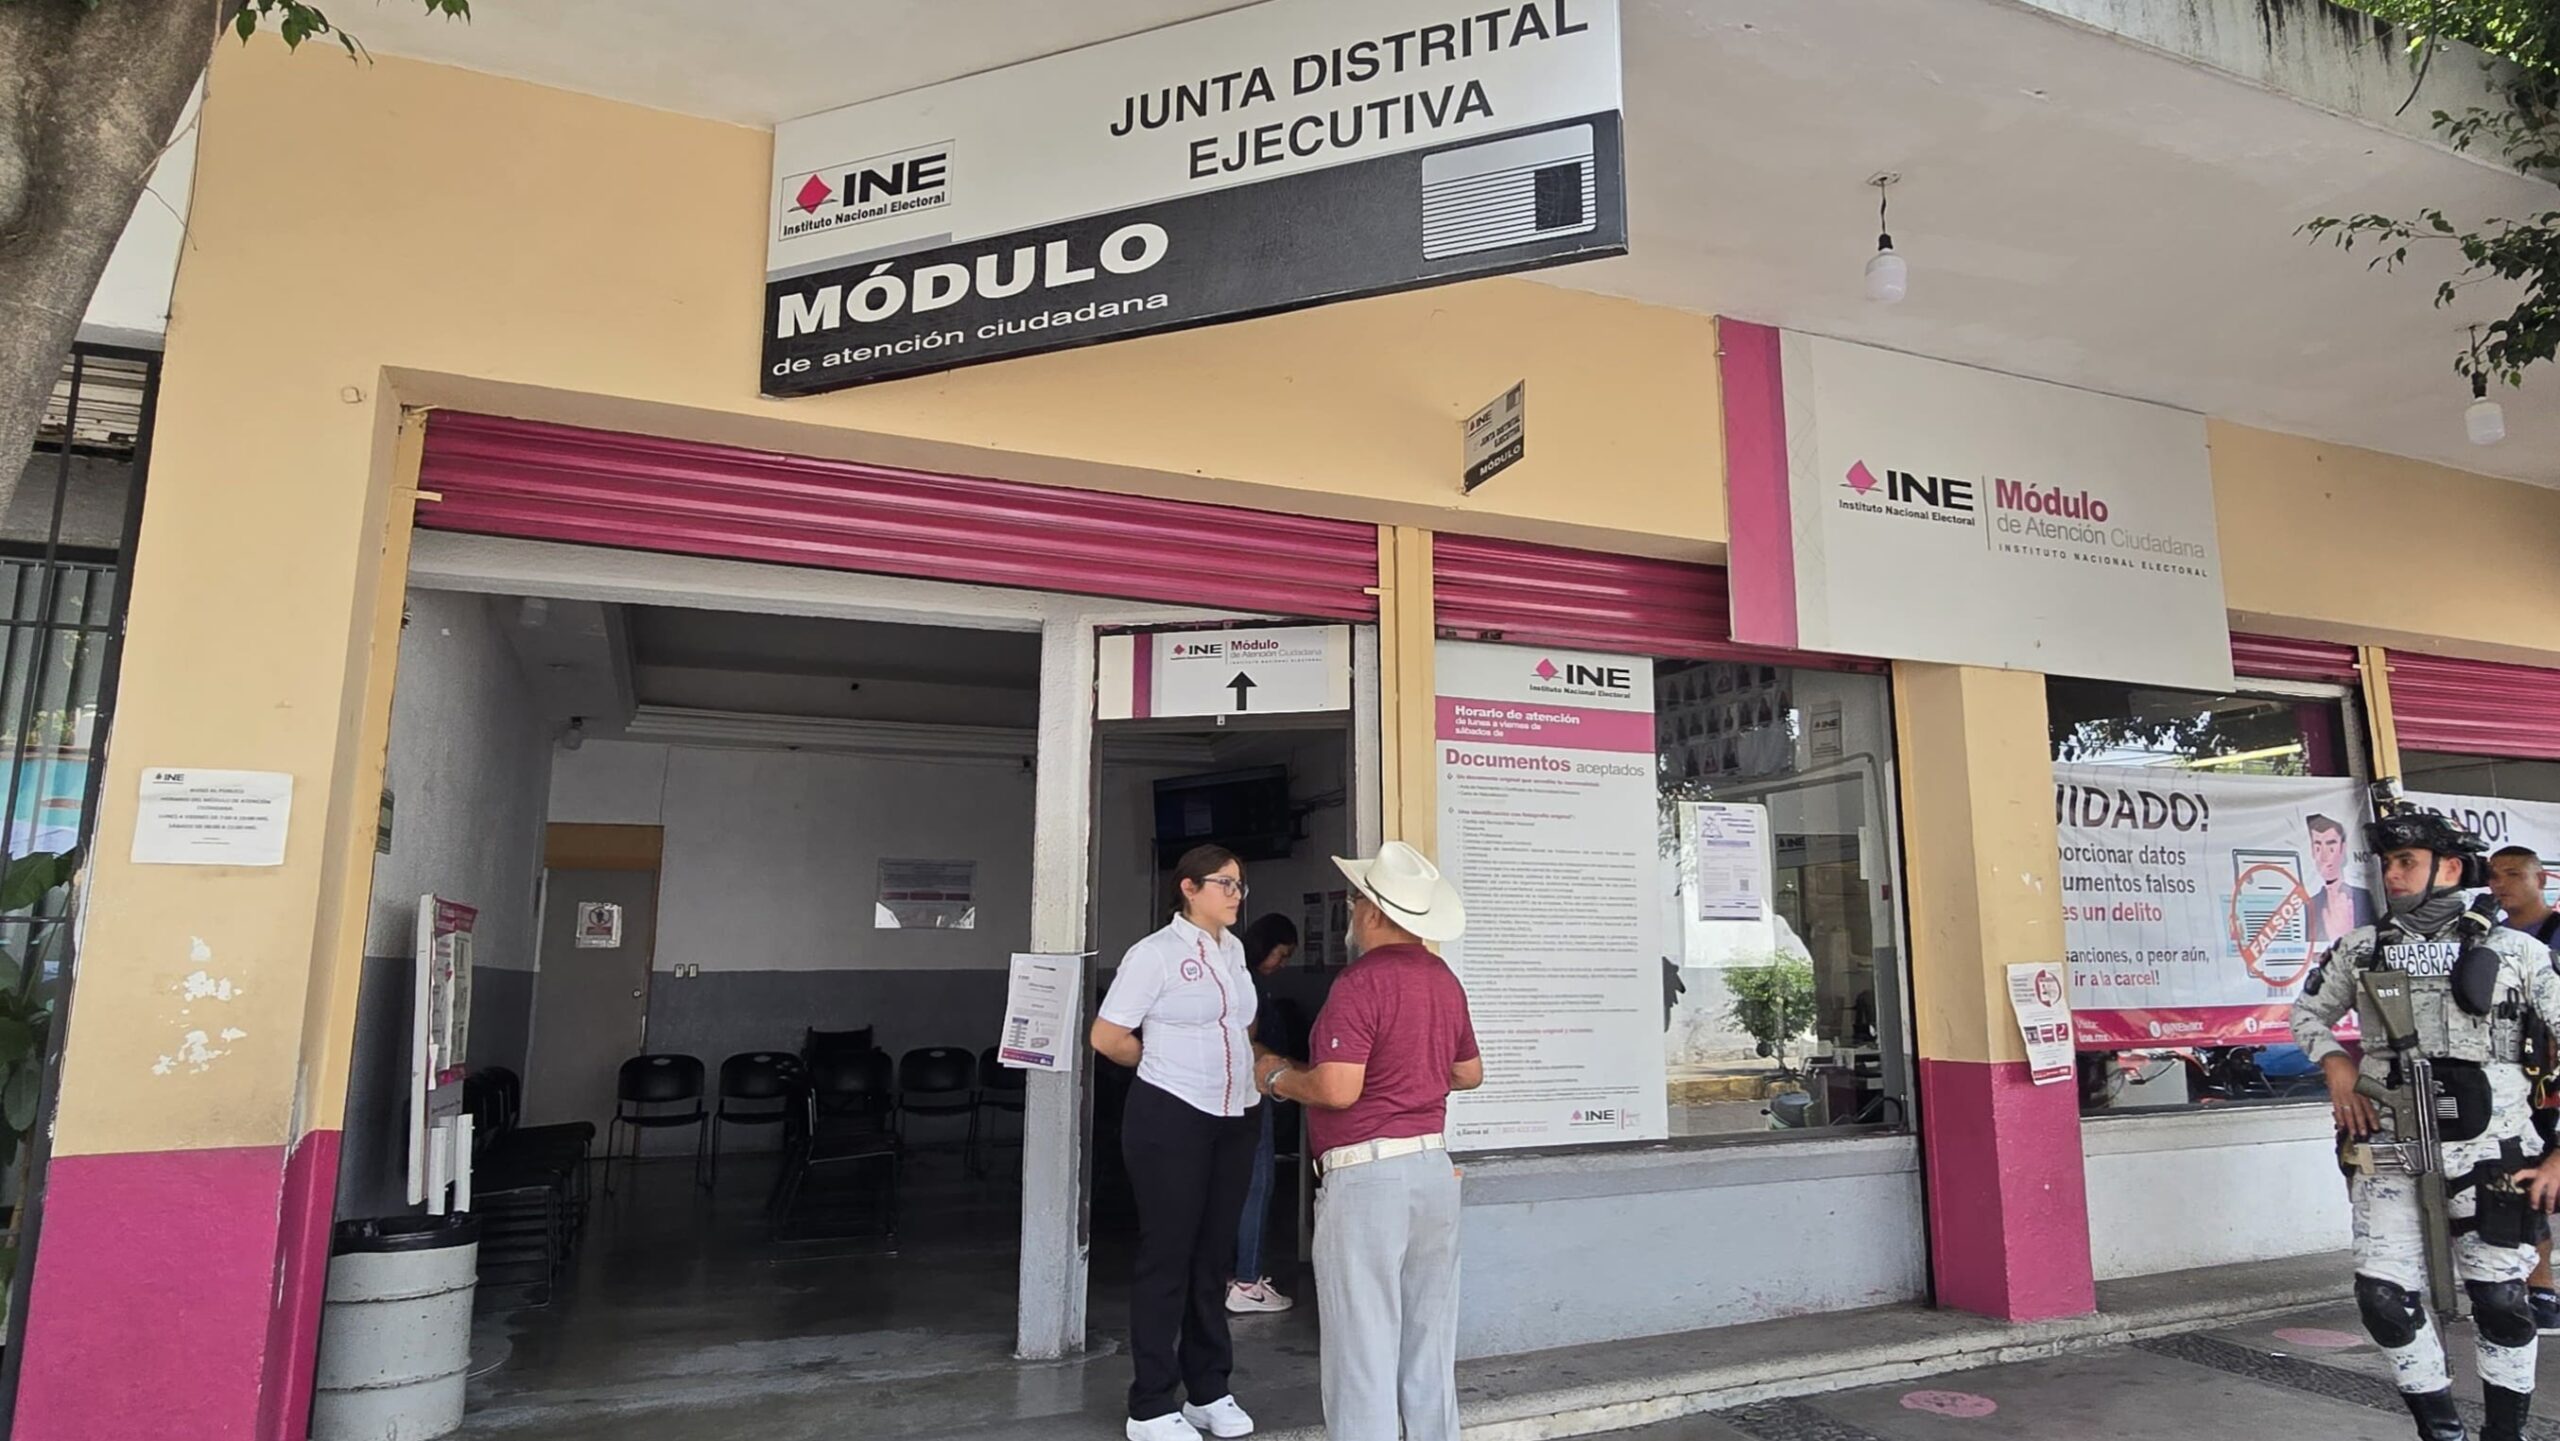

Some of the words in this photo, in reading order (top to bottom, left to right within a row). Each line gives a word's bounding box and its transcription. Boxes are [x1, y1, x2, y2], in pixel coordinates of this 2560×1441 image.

[1110, 66, 1276, 138] JUNTA
[1293, 0, 1589, 96] DISTRITAL
[1189, 79, 1494, 180] EJECUTIVA
[843, 153, 946, 208] INE
[783, 216, 832, 236] Instituto
[835, 204, 887, 225] Nacional
[890, 192, 945, 213] Electoral
[777, 223, 1169, 339] MÓDULO
[773, 357, 811, 377] de
[823, 330, 964, 369] atención
[977, 293, 1168, 340] ciudadana
[1887, 470, 1973, 511] INE
[1995, 478, 2108, 522] Módulo
[1839, 499, 1883, 513] Instituto
[1885, 506, 1929, 520] Nacional
[1932, 512, 1975, 526] Electoral
[1997, 513, 2021, 534] de
[2025, 517, 2106, 545] Atención
[2110, 528, 2205, 559] Ciudadana
[1999, 543, 2067, 559] INSTITUTO
[2074, 553, 2135, 568] NACIONAL
[2141, 561, 2208, 578] ELECTORAL
[1189, 643, 1223, 655] INE
[1231, 639, 1279, 650] Módulo
[1567, 664, 1630, 689] INE
[1564, 688, 1596, 696] Nacional
[1455, 705, 1504, 719] Horario
[1506, 709, 1523, 720] de
[1525, 711, 1580, 725] atención
[1455, 717, 1466, 725] de
[1467, 718, 1491, 727] lunes
[1499, 720, 1529, 730] viernes
[1446, 748, 1571, 773] Documentos
[1576, 760, 1645, 779] aceptados
[2139, 845, 2186, 865] datos
[2145, 874, 2196, 893] falsos
[2082, 906, 2106, 922] un
[2112, 902, 2162, 922] delito
[2249, 894, 2304, 958] FALSOS
[2135, 951, 2144, 963] o
[2147, 949, 2178, 966] peor
[2181, 946, 2210, 963] aún,
[2387, 944, 2456, 961] GUARDIA
[2075, 971, 2087, 986] ir
[2090, 974, 2099, 986] a
[2101, 971, 2112, 986] la
[2114, 969, 2160, 986] carcel!
[1585, 1110, 1615, 1121] INE
